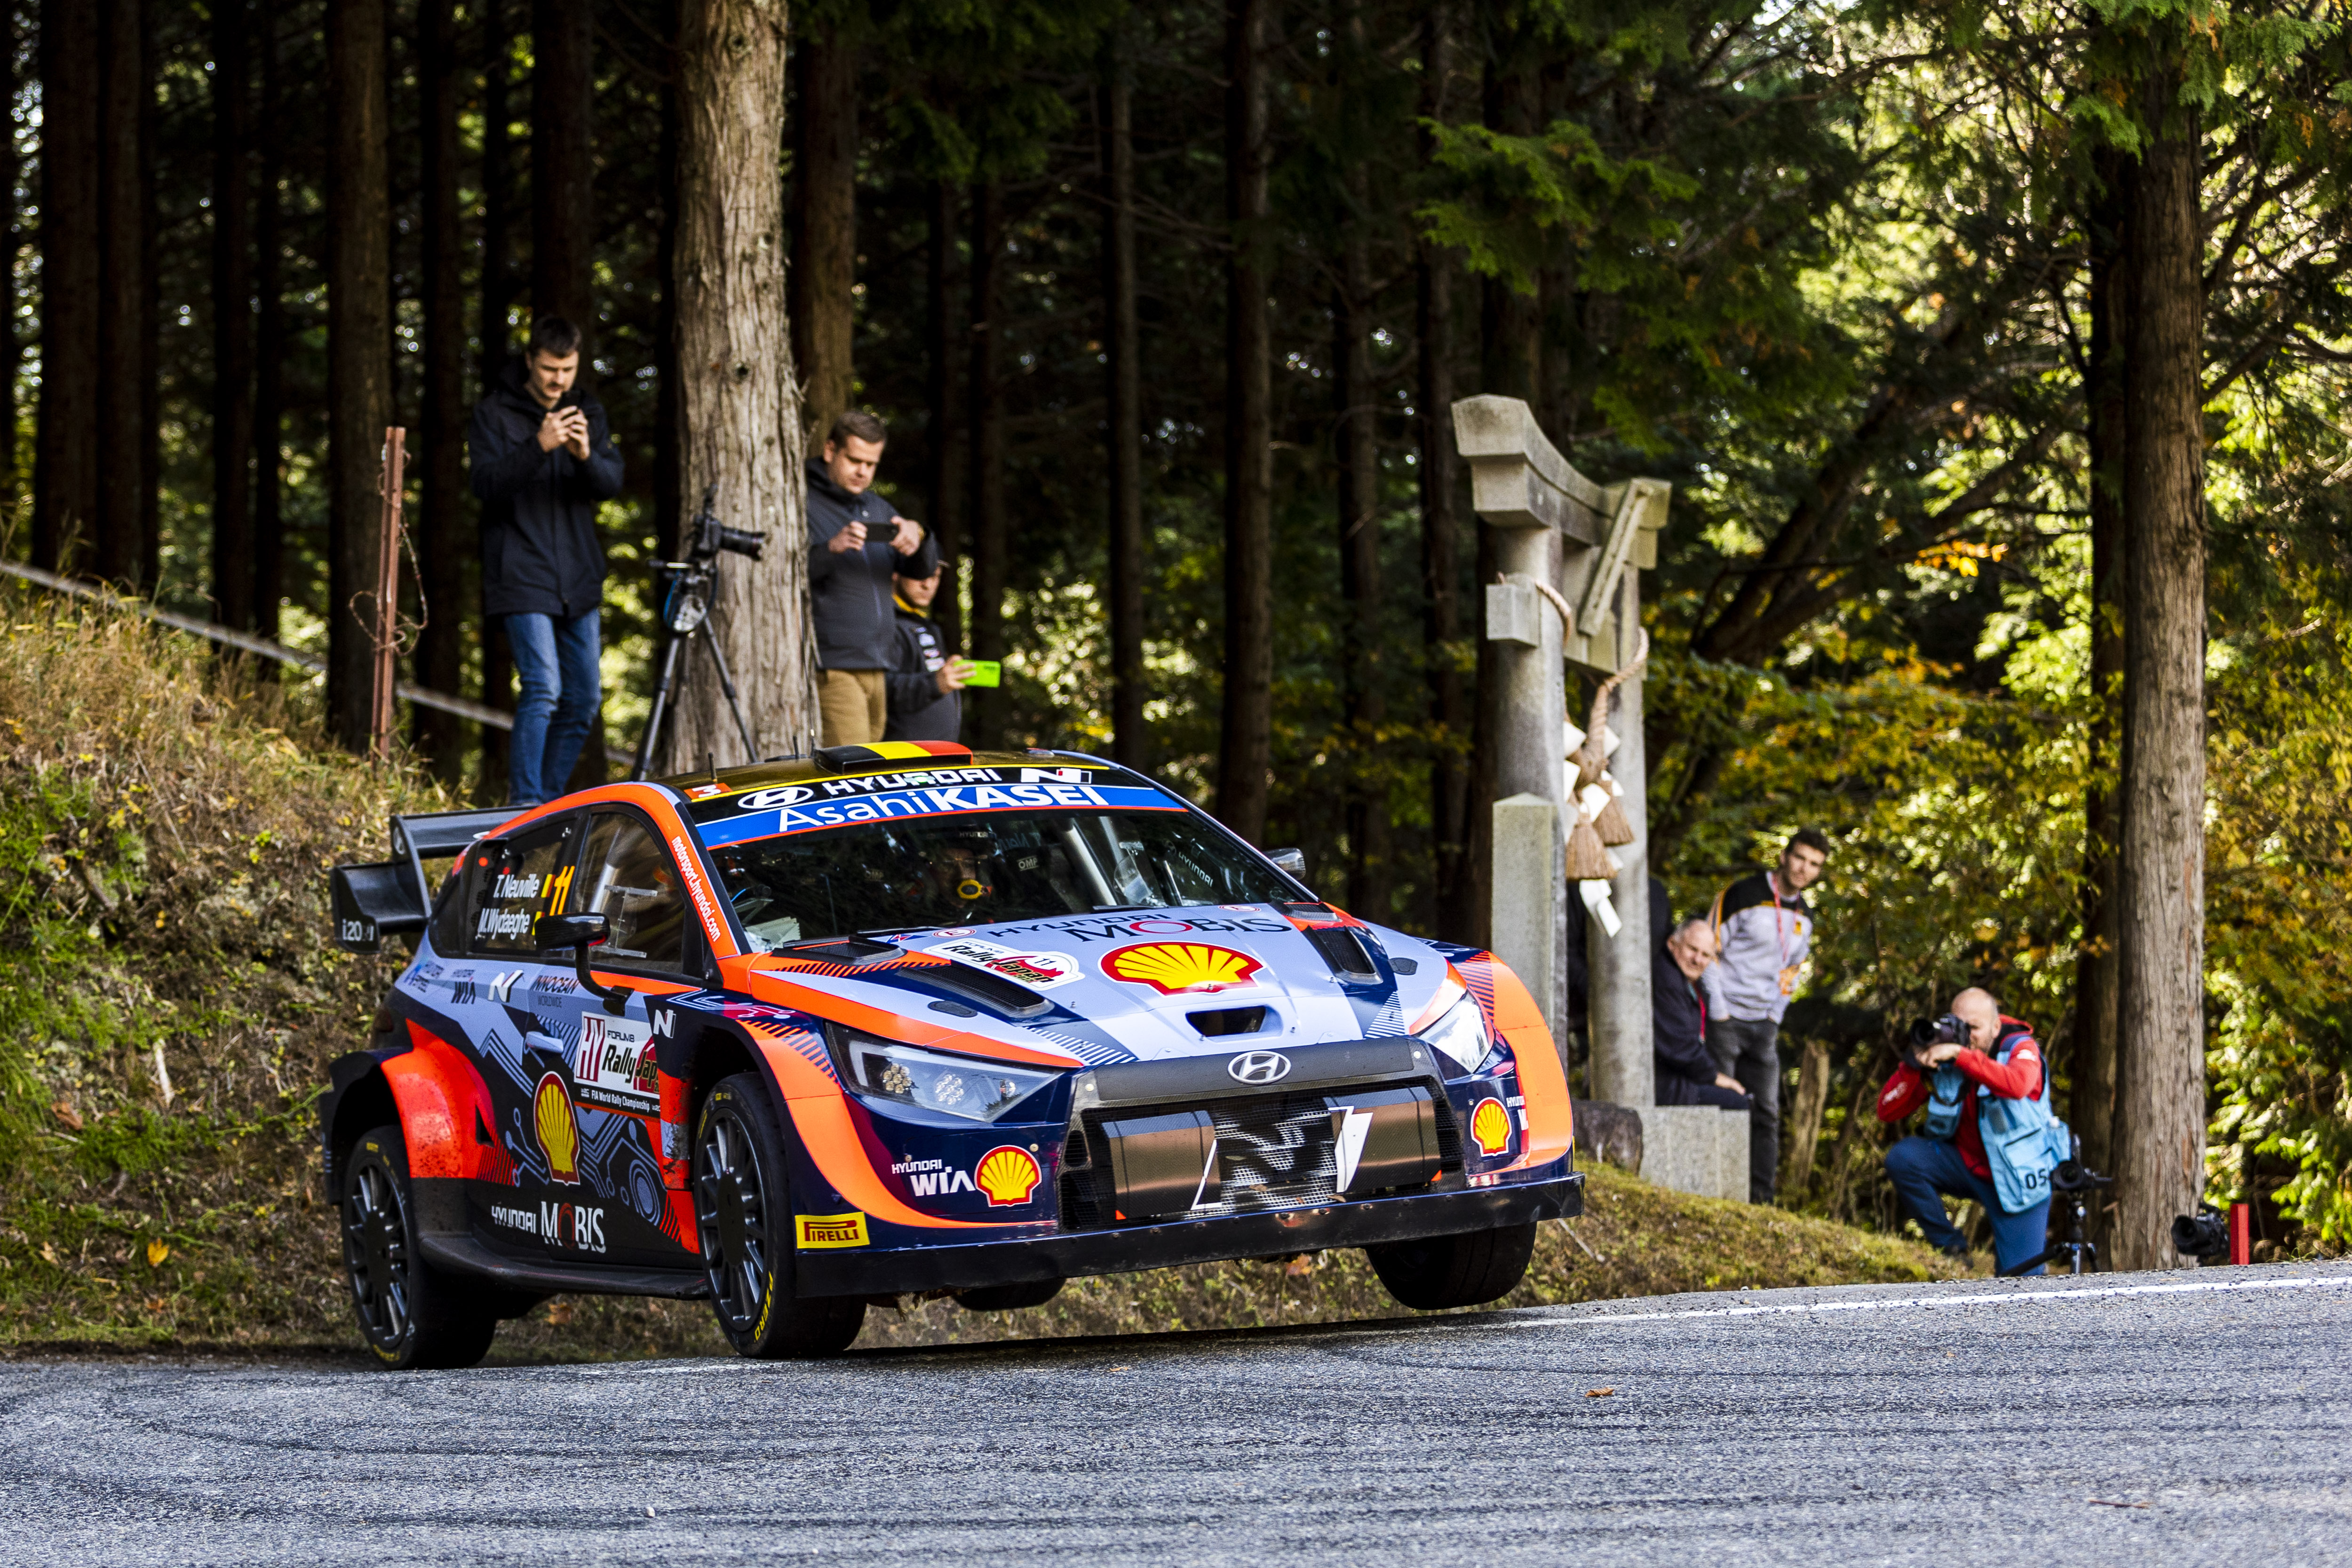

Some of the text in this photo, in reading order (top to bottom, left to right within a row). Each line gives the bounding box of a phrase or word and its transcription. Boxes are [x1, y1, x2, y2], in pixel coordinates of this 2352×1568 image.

[822, 768, 1002, 795] HYUNDAI
[1178, 852, 1213, 887] HYUNDAI
[501, 873, 540, 898] Neuville
[549, 866, 575, 916] 11
[672, 836, 721, 942] motorsport.hyundai.com
[342, 918, 363, 941] i20
[988, 914, 1172, 937] HYUNDAI
[1060, 918, 1292, 942] MOBIS
[942, 945, 1055, 983] Rally Japan
[532, 975, 580, 995] INNOCEAN
[537, 995, 563, 1008] WORLDWIDE
[607, 1030, 635, 1043] FORUM8
[602, 1043, 659, 1089] Rally Jap
[599, 1091, 611, 1103] World
[612, 1093, 621, 1107] Rally
[622, 1096, 650, 1113] Championship
[891, 1159, 942, 1174] HYUNDAI
[910, 1166, 976, 1196] WIA
[492, 1205, 536, 1234] HYUNDAI
[541, 1201, 606, 1253] MOBIS
[803, 1219, 860, 1242] PIRELLI
